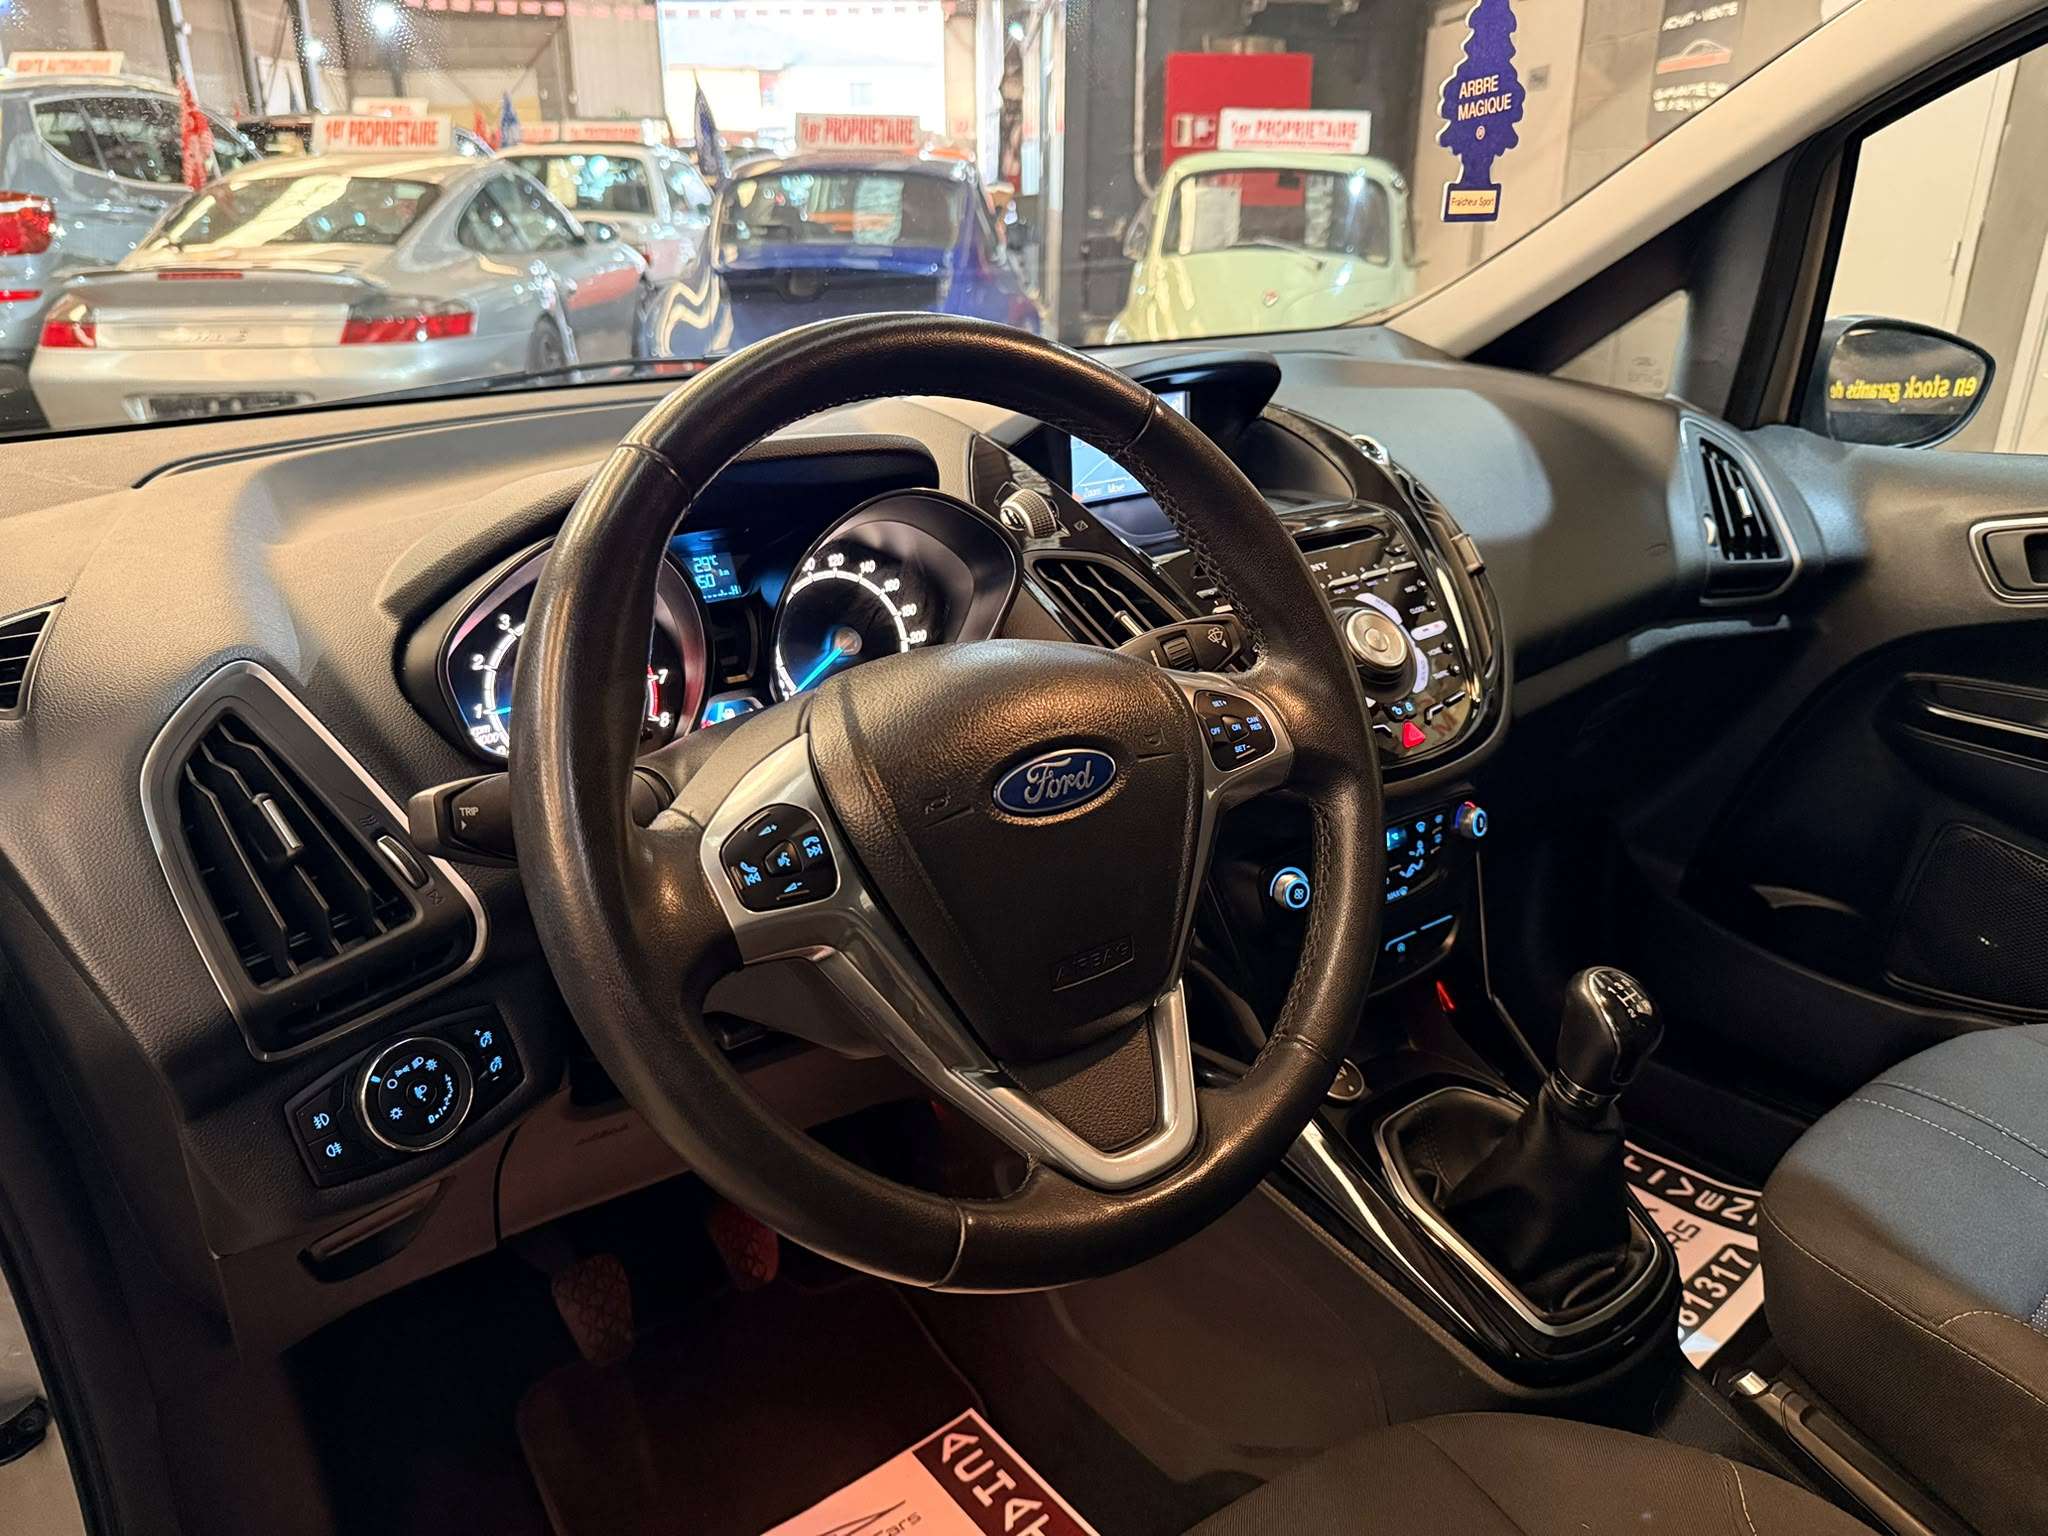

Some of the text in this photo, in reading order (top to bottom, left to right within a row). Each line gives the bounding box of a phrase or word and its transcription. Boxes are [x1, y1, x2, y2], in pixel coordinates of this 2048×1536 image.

[1458, 75, 1500, 100] ARBRE
[1457, 92, 1513, 121] MAGIQUE
[348, 120, 439, 146] PROPRIETAIRE
[1254, 120, 1360, 140] PROPRIETAIRE
[860, 560, 875, 574] 140
[1310, 562, 1328, 572] NY
[498, 614, 510, 630] 3
[909, 629, 927, 643] 200
[472, 654, 484, 671] 2
[658, 669, 668, 684] 7
[473, 704, 482, 719] 1
[659, 712, 670, 727] 8
[1024, 757, 1095, 804] Ford
[459, 806, 479, 817] TRIP
